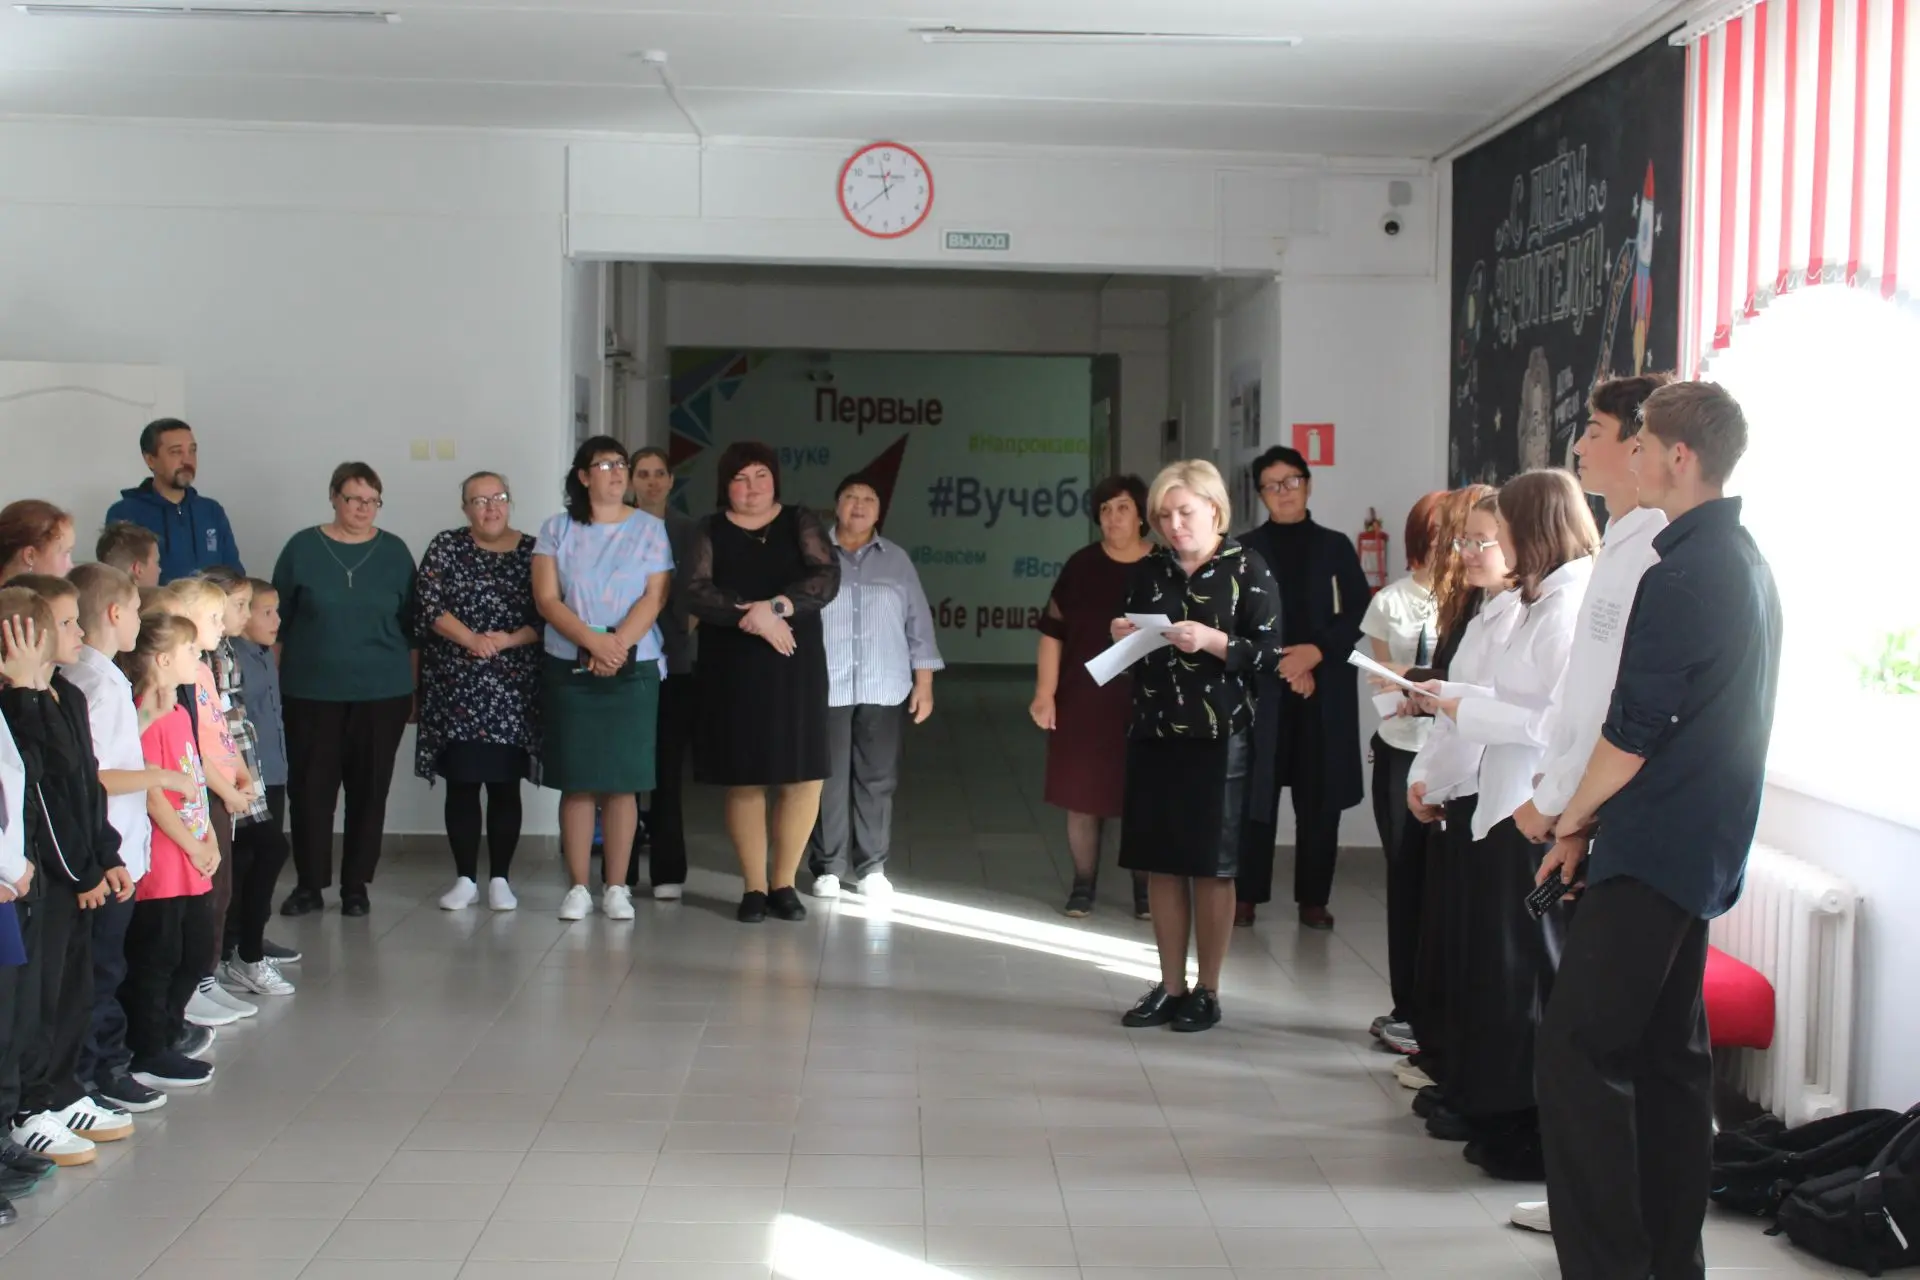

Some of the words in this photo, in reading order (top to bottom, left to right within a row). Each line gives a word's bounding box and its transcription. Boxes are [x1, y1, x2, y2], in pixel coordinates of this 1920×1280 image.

[949, 234, 1006, 249] ВЫХОД
[815, 388, 943, 435] Первые
[968, 433, 1090, 457] #Напроизво
[775, 445, 830, 471] ауке
[1013, 556, 1065, 578] #Всп
[976, 604, 1044, 639] реша
